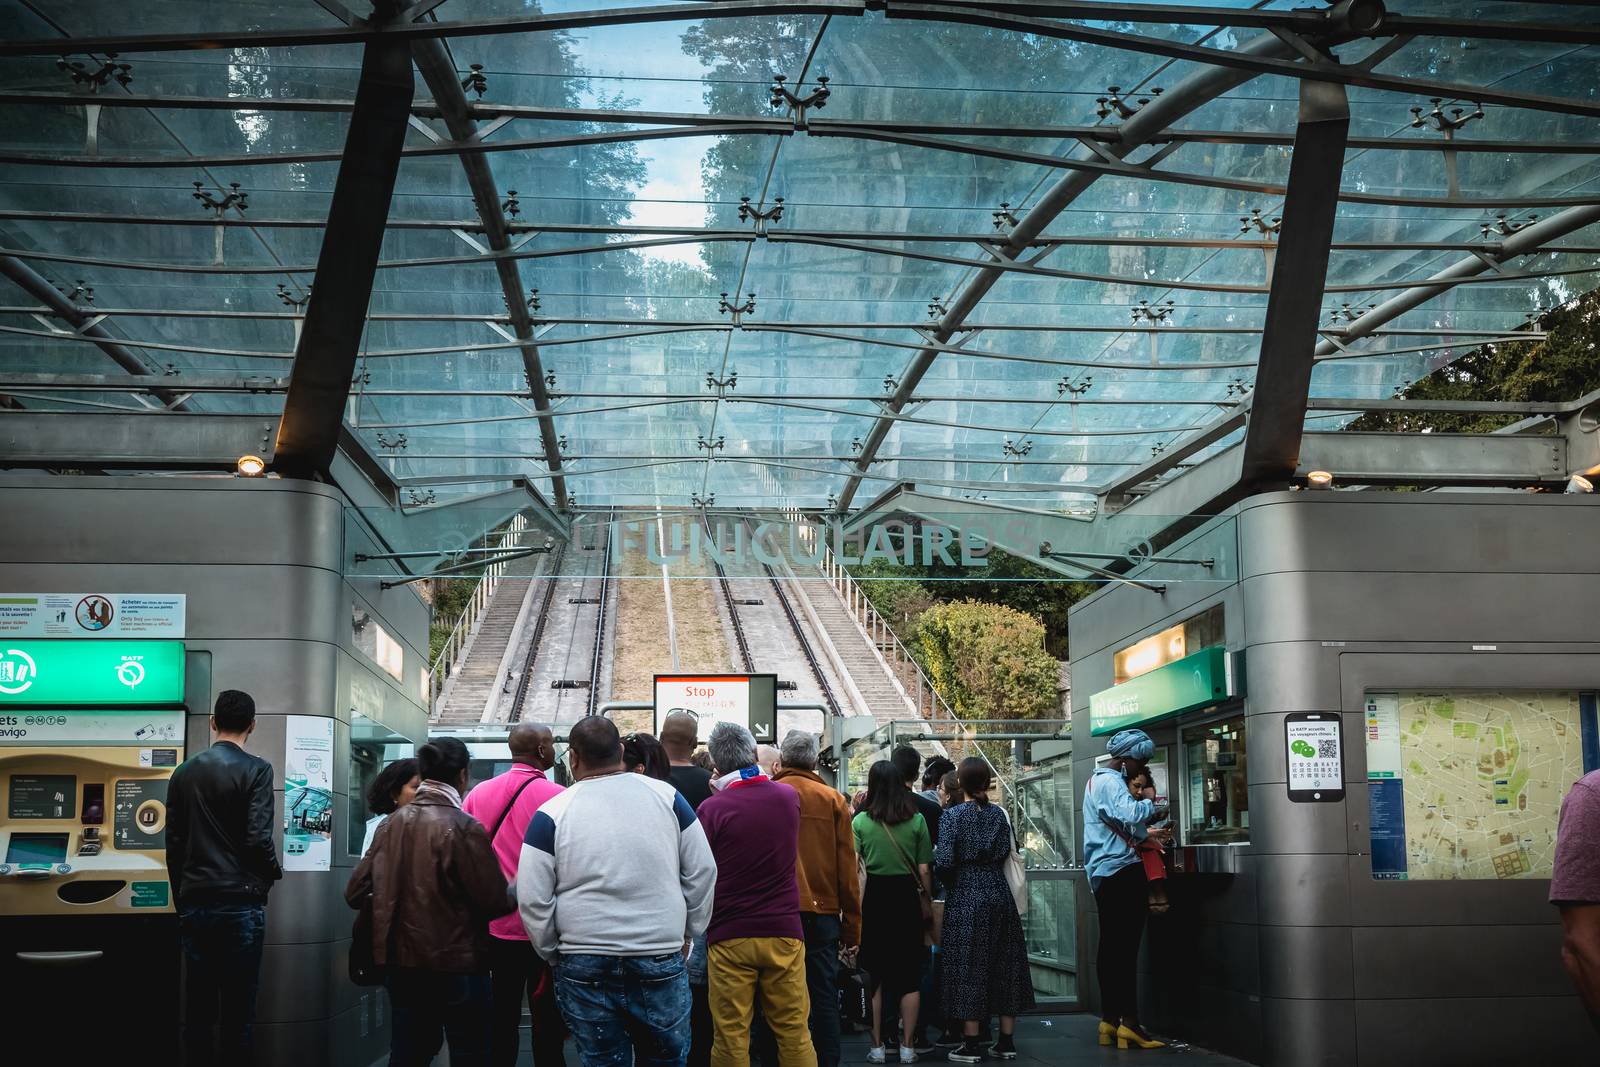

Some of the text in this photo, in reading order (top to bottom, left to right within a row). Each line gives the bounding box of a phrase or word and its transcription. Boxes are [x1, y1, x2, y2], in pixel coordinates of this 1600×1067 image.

[611, 521, 989, 567] FUNICULAIRE
[686, 686, 715, 699] Stop
[0, 715, 17, 726] ets
[0, 727, 27, 739] avigo
